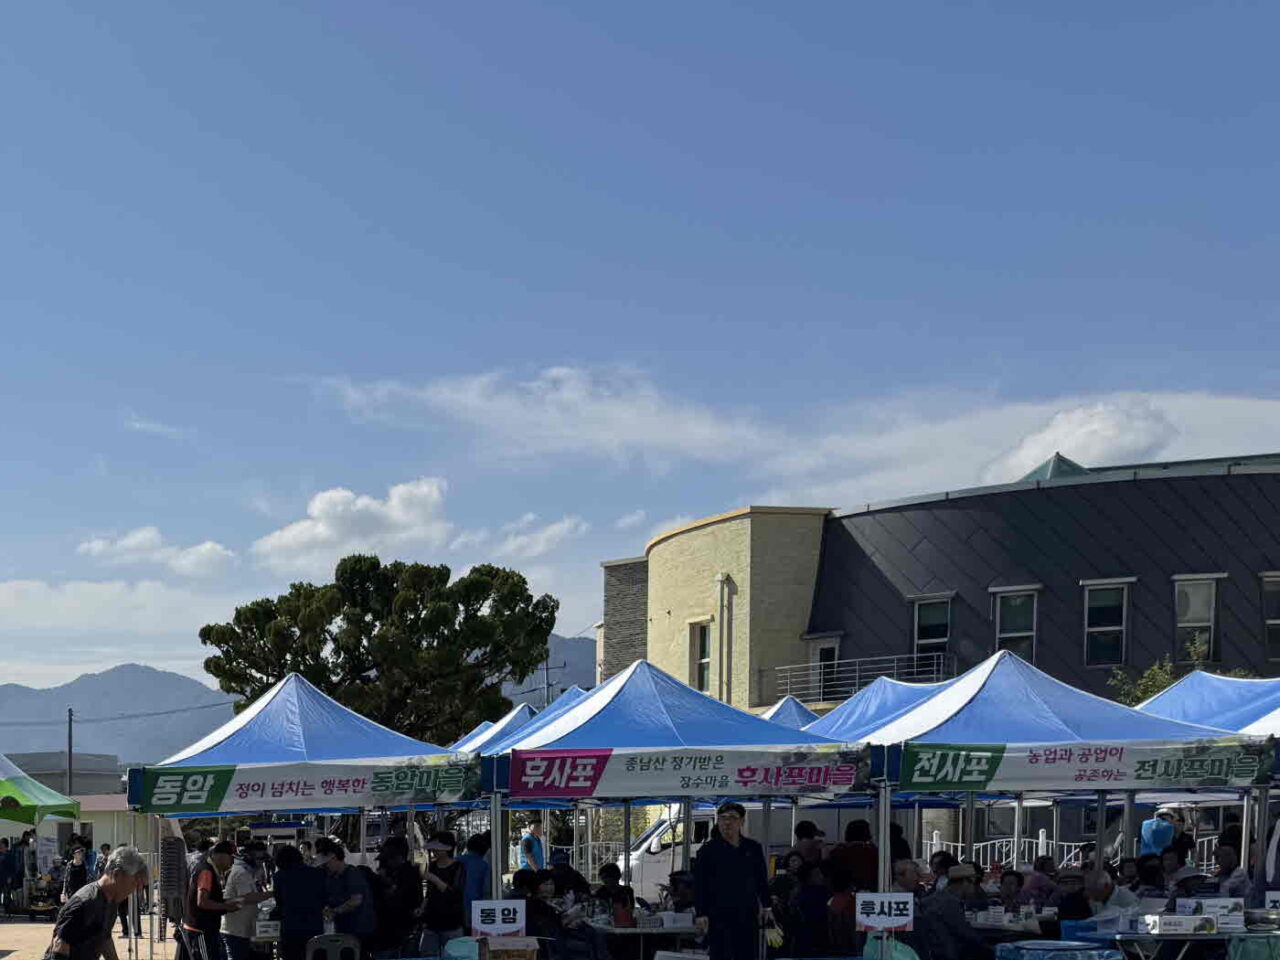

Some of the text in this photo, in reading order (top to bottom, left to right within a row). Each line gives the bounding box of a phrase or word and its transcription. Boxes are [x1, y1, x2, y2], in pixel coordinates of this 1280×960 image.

[624, 754, 725, 772] 종남산 정기받은
[1027, 746, 1124, 764] 농업과 공업이
[521, 756, 598, 789] 후사포
[734, 764, 858, 787] 후사포마을
[913, 751, 991, 783] 전사포
[1073, 769, 1127, 782] 공존하는
[1133, 754, 1261, 780] 전사포마을
[151, 774, 215, 805] 동암
[235, 767, 466, 798] 정이 넘치는 행복한 동암마을
[679, 775, 731, 789] 장수마을
[480, 908, 519, 924] 동암
[860, 901, 910, 917] 후사포
